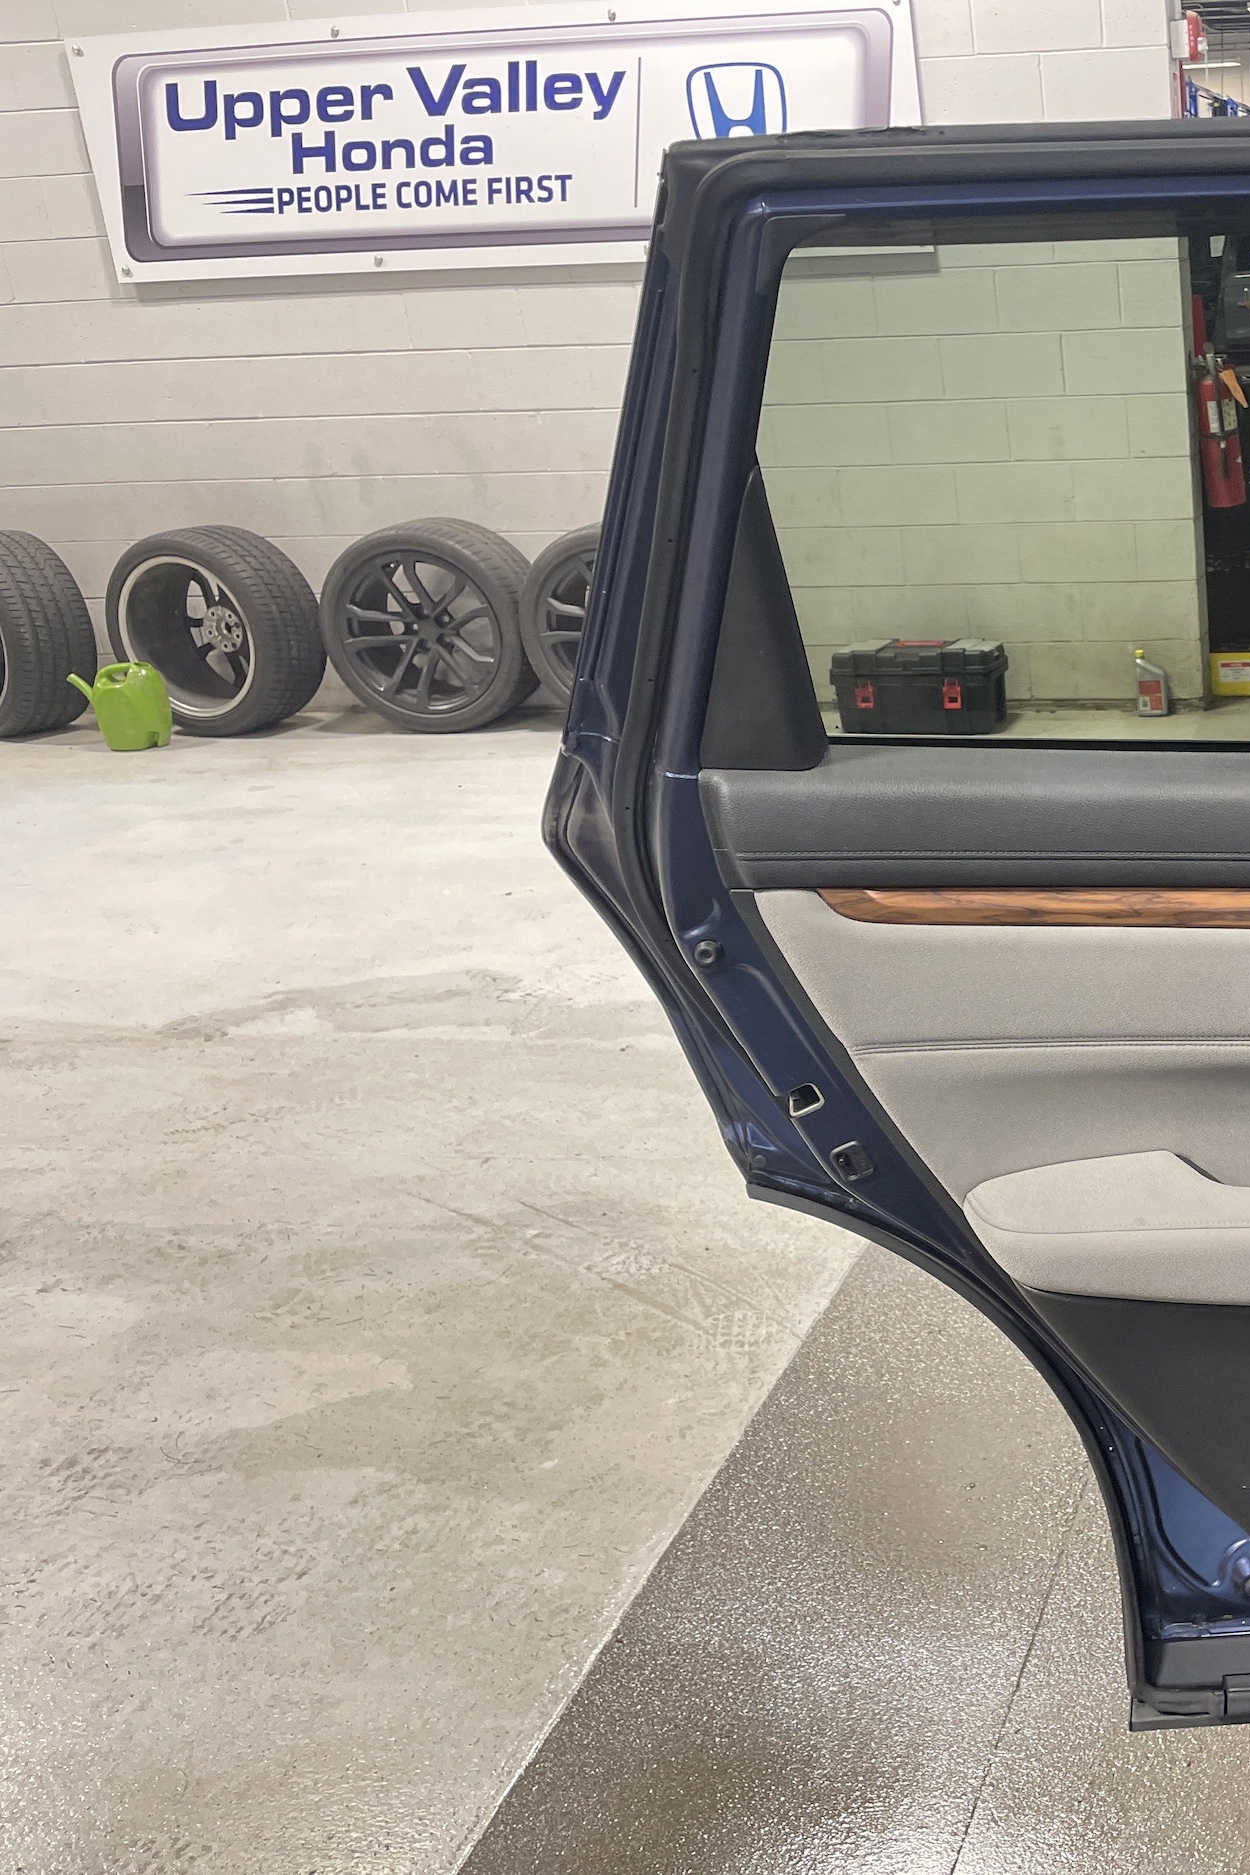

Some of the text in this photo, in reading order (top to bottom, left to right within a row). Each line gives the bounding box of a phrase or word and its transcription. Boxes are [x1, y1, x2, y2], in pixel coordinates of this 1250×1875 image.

[165, 60, 627, 141] Upper Valley
[291, 123, 494, 175] Honda
[277, 174, 573, 215] PEOPLE COME FIRST
